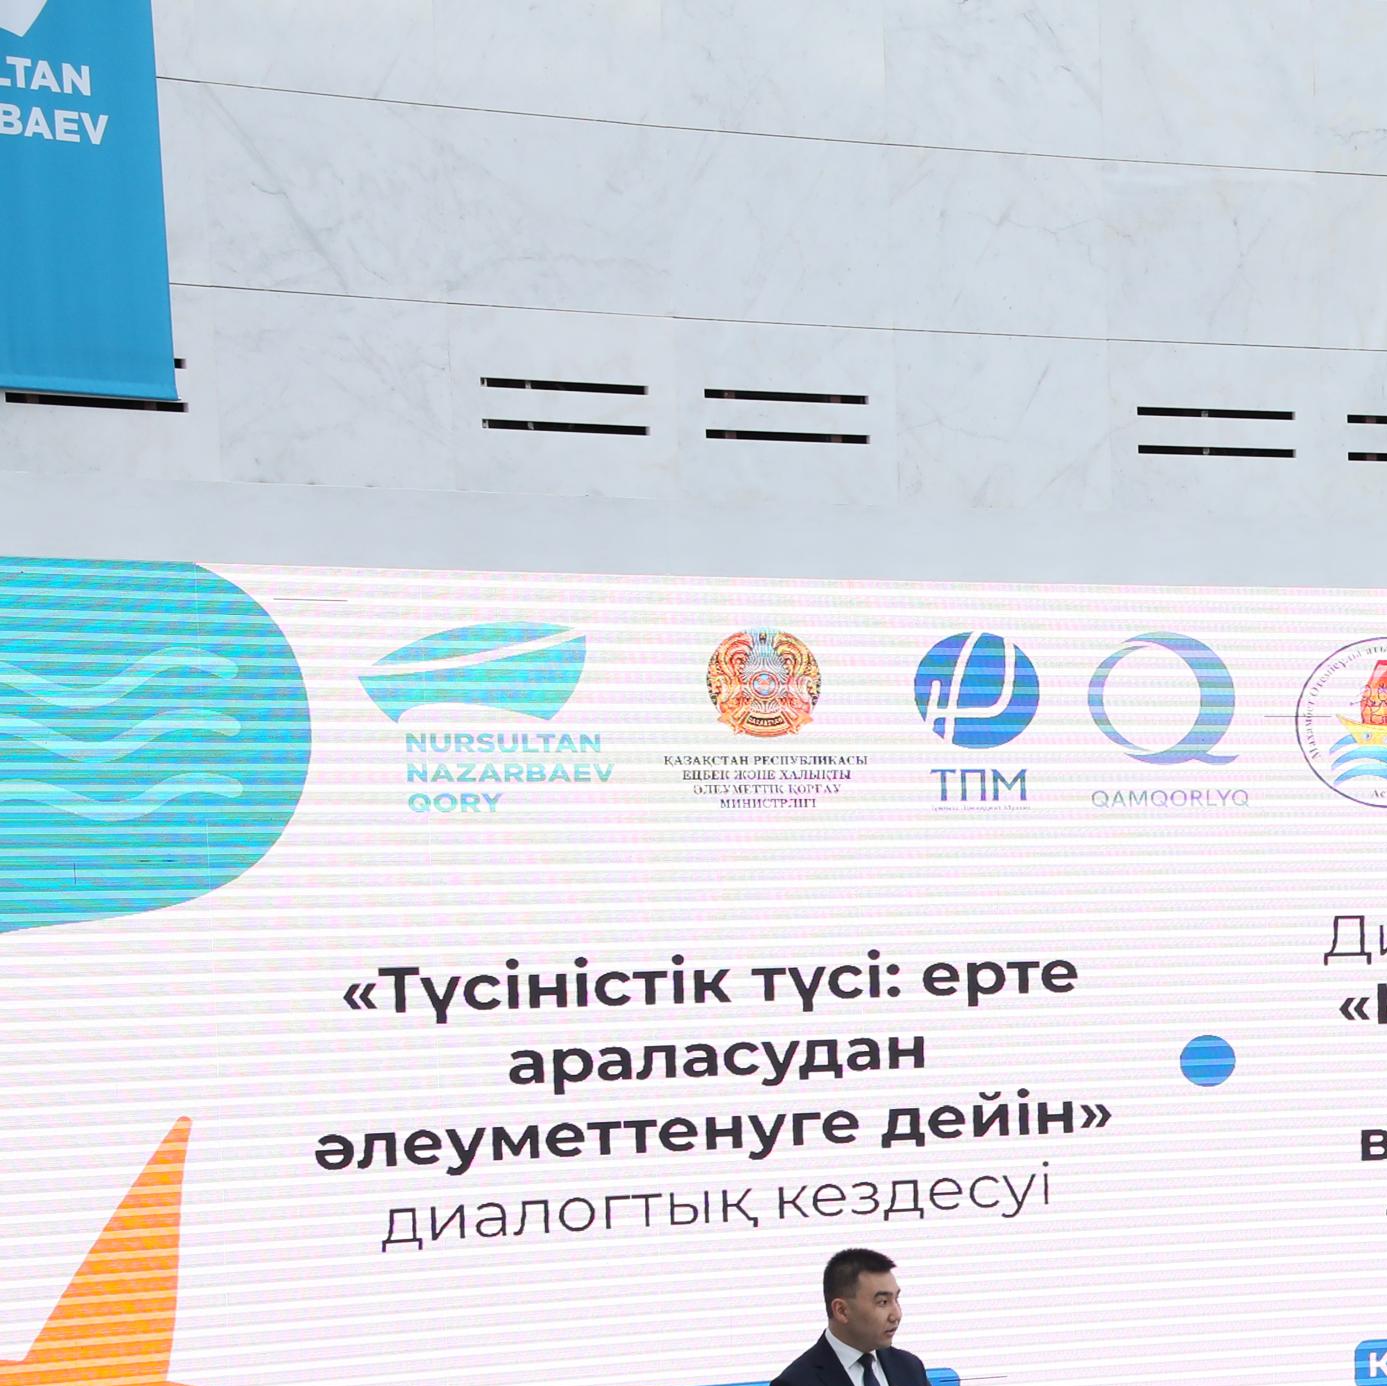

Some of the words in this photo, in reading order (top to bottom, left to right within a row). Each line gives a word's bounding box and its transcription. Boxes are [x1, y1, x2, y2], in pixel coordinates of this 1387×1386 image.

[405, 732, 601, 753] NURSULTAN
[406, 762, 616, 783] NAZARBAEV
[753, 755, 869, 766] РЕСПУБЛИКАСЫ
[930, 769, 1028, 801] ТПМ
[1090, 788, 1249, 808] QAMQORLYQ
[408, 792, 503, 813] QORY
[343, 954, 731, 1024] «Түсіністік
[751, 949, 900, 1012] түсі:
[923, 960, 1077, 1006] ерте
[509, 1036, 924, 1095] араласудан
[315, 1110, 859, 1176] әлеуметтенуге
[882, 1088, 1111, 1148] дейін»
[382, 1189, 758, 1252] диалогтық
[779, 1161, 1048, 1221] кездесуі
